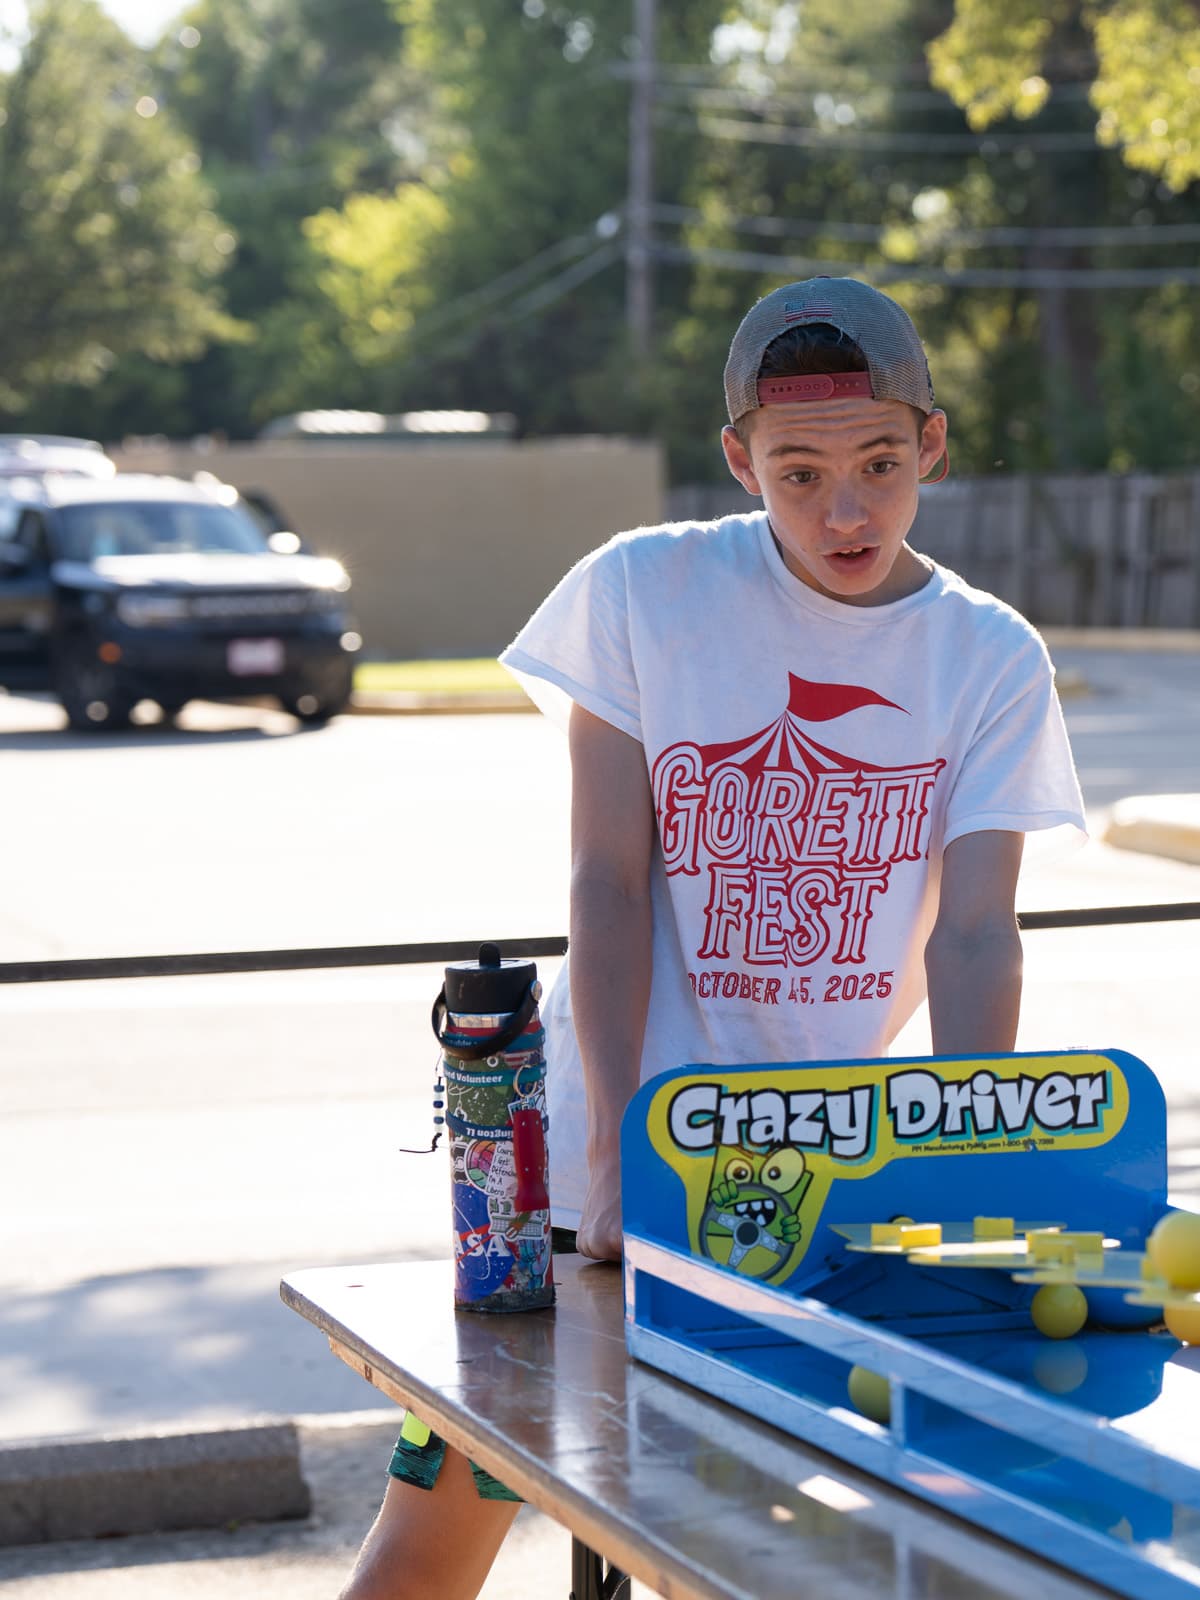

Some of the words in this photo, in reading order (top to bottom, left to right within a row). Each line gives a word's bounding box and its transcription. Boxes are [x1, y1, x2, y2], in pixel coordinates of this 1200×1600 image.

[697, 860, 891, 968] FEST
[822, 970, 895, 1003] 2025
[456, 1073, 503, 1083] Volunteer
[667, 1082, 879, 1162] Crazy
[885, 1069, 1112, 1140] Driver
